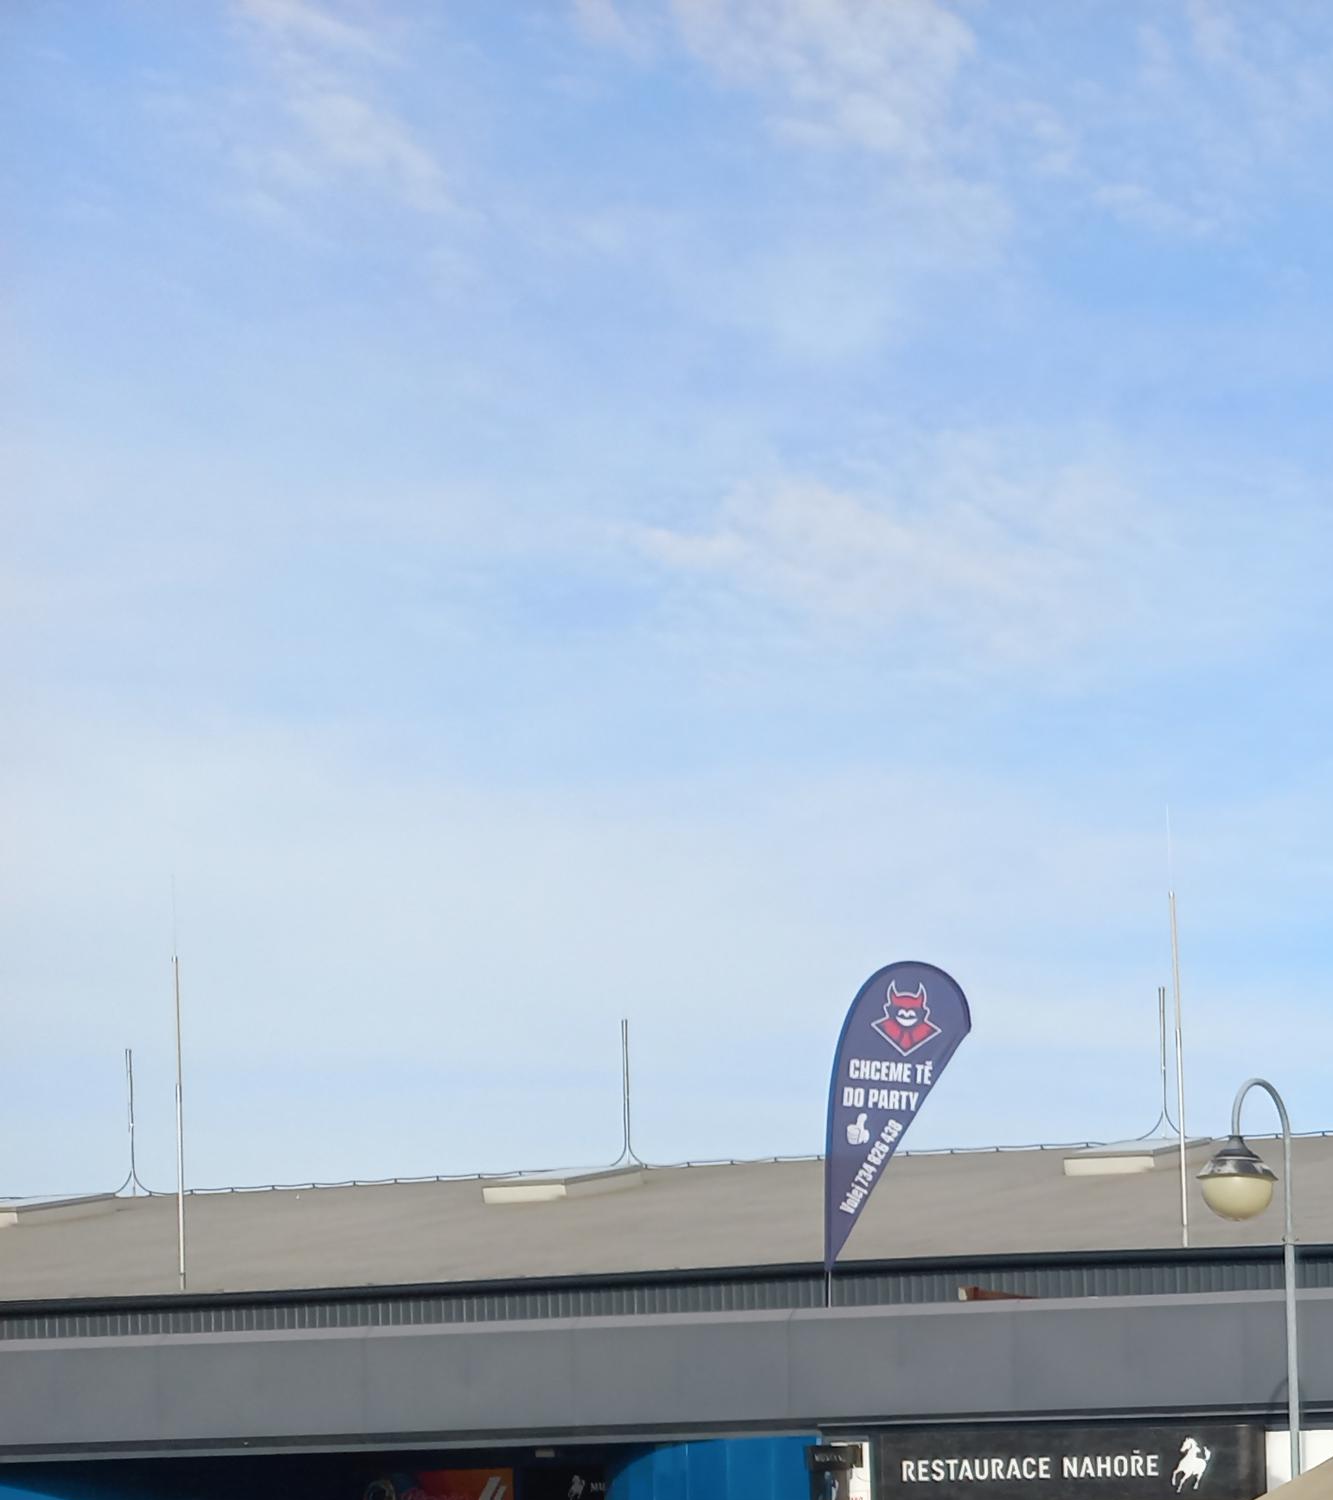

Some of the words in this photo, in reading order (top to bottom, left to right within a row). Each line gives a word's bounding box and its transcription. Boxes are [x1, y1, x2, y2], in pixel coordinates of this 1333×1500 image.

[849, 1058, 912, 1083] CHCEME
[915, 1060, 933, 1085] TĚ
[842, 1086, 865, 1108] DO
[867, 1088, 919, 1111] PARTY
[839, 1183, 868, 1214] Volej
[854, 1163, 878, 1188] 734
[867, 1140, 890, 1166] 826
[901, 1456, 1051, 1483] RESTAURACE
[1062, 1449, 1160, 1479] NAHOŘE
